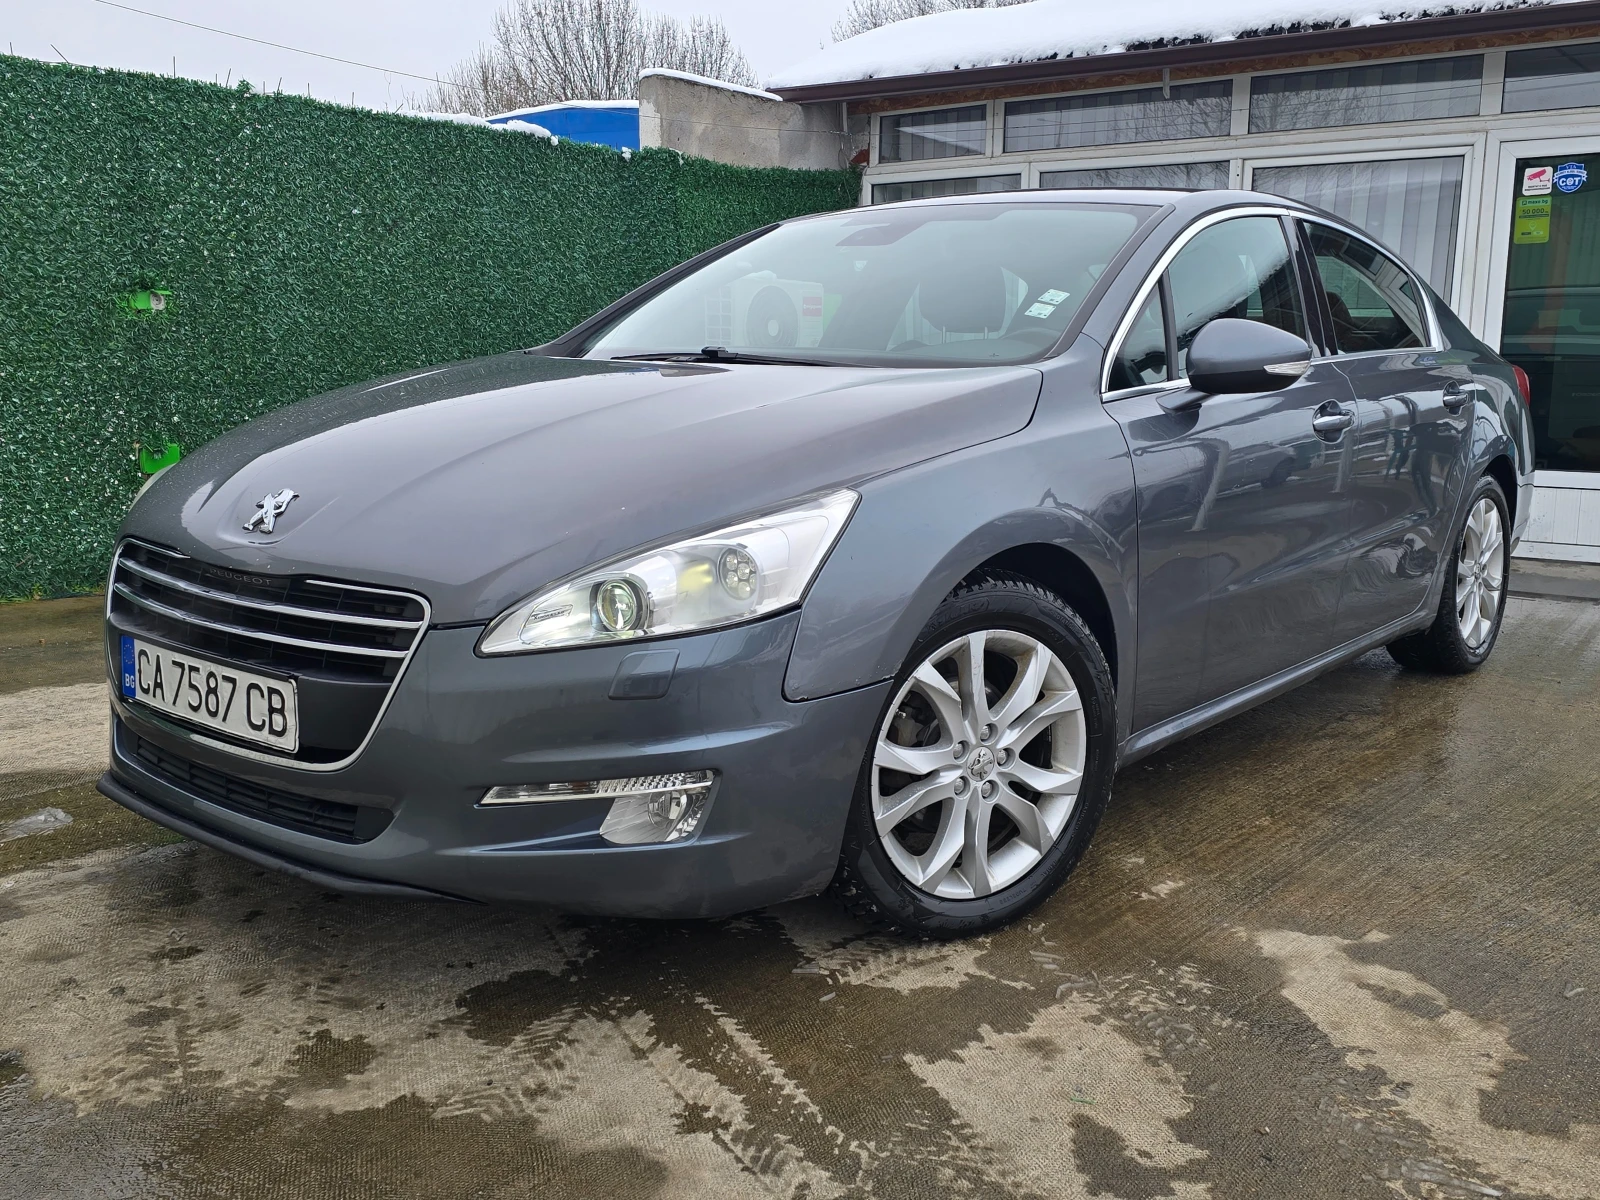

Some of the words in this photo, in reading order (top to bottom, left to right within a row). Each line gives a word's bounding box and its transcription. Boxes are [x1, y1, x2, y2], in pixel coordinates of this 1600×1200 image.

[210, 568, 272, 585] PEUGEOT
[125, 673, 135, 688] BG
[137, 648, 166, 702] CA
[171, 659, 237, 723] 7587
[246, 682, 288, 737] CB
